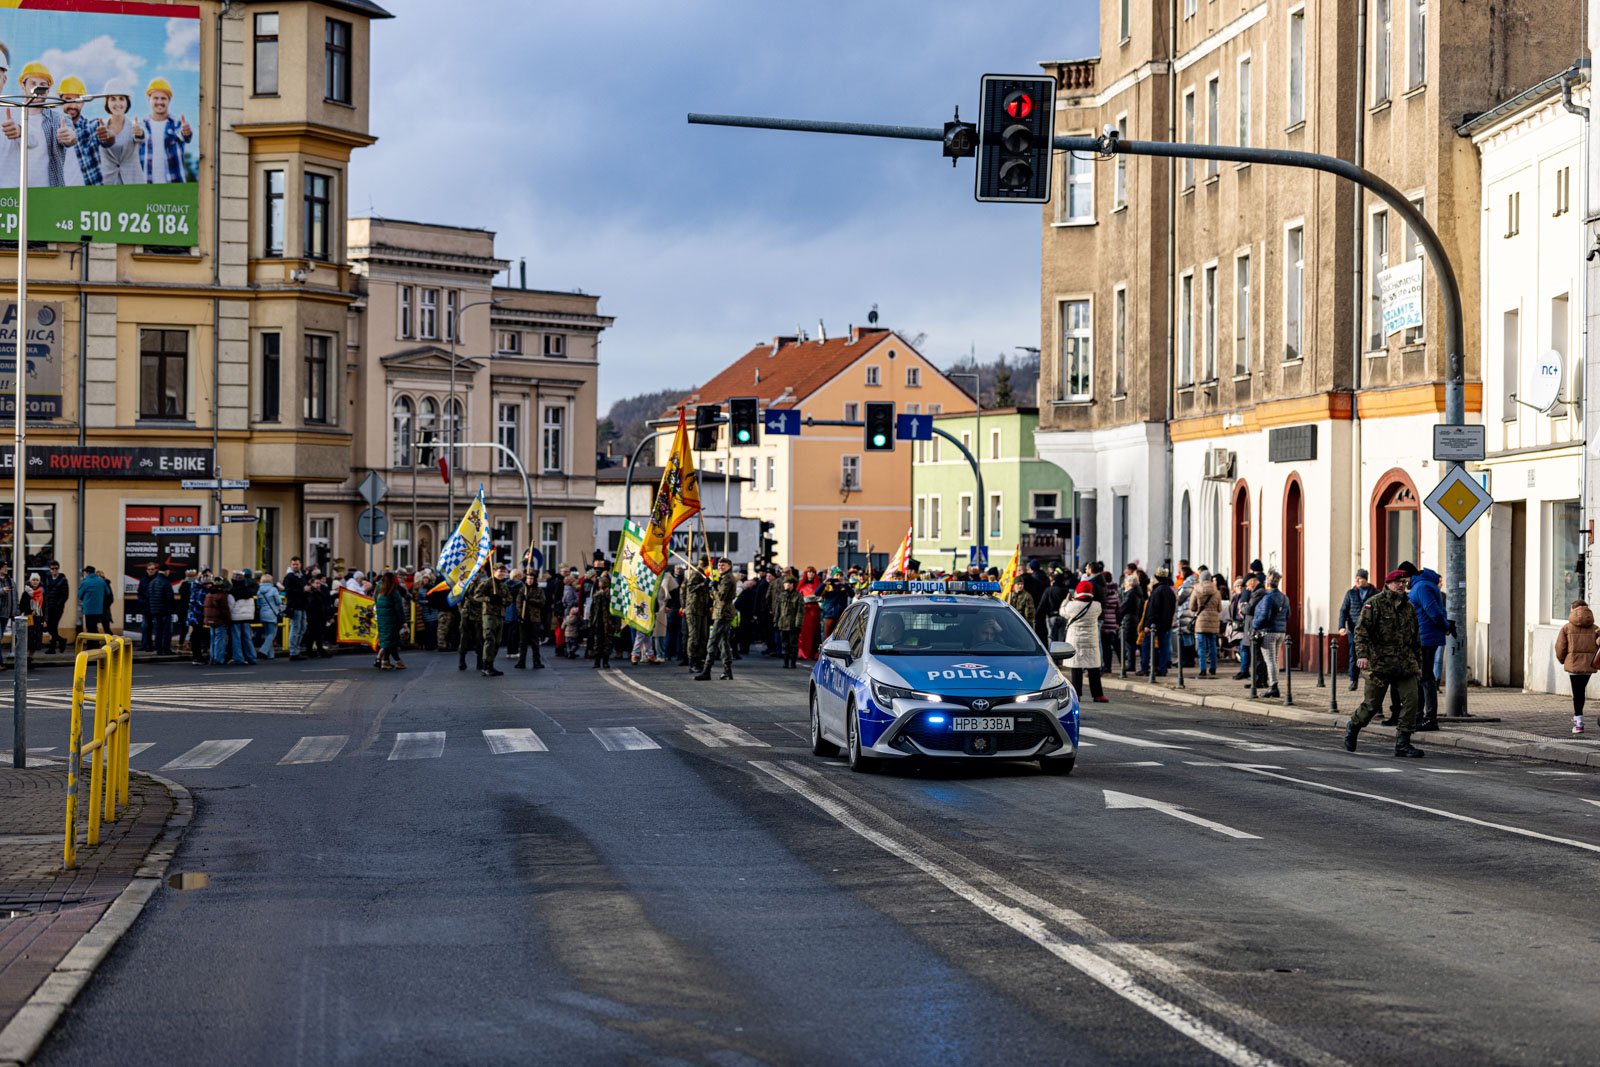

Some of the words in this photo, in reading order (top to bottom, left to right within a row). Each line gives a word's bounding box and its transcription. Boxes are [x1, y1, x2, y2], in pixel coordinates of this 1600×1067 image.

[146, 203, 190, 214] KONTAKT
[55, 220, 73, 230] +48
[80, 211, 111, 232] 510
[118, 213, 150, 233] 926
[157, 214, 189, 234] 184
[50, 454, 133, 469] ROWEROWY
[159, 456, 206, 470] E-BIKE
[910, 581, 945, 591] POLICJA
[927, 669, 1023, 681] POLICJA
[955, 718, 978, 730] HPB
[982, 718, 1011, 730] 33BA
